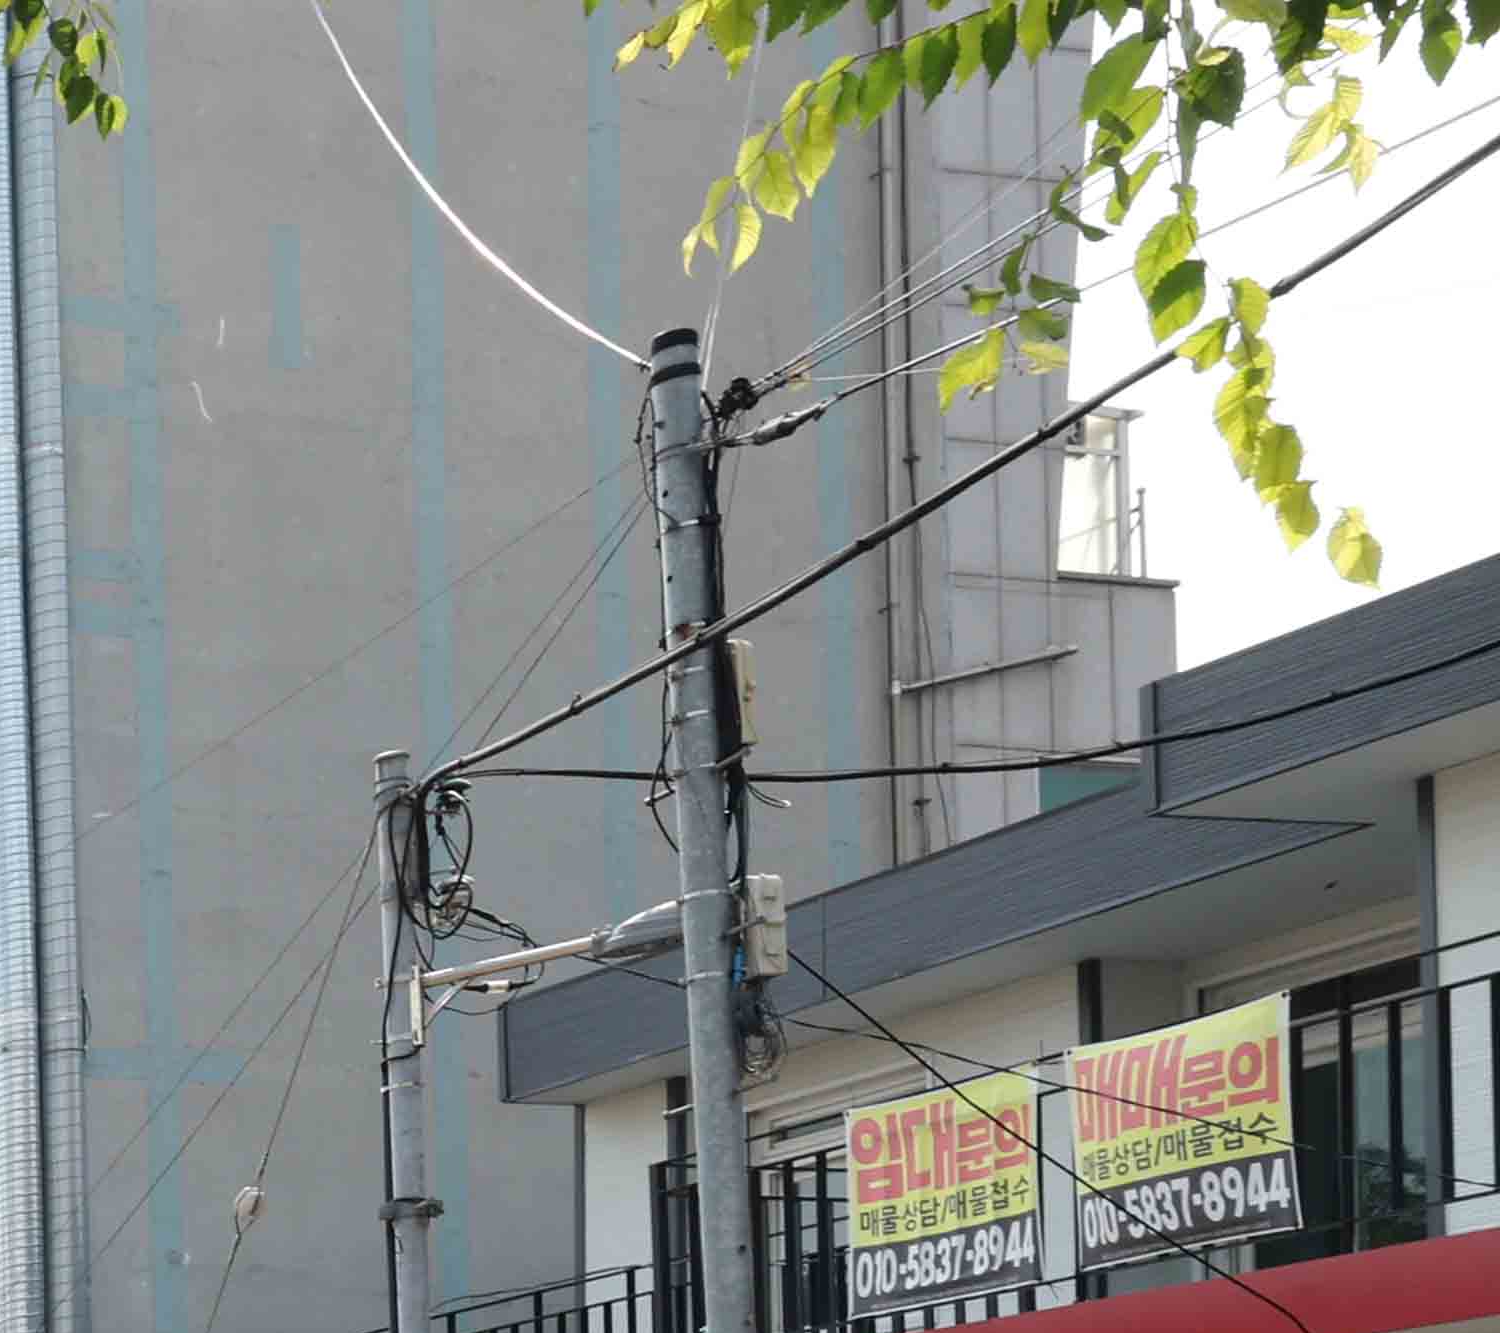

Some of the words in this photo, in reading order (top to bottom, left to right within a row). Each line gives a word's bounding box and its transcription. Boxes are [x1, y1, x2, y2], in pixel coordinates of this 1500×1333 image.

[1075, 1034, 1280, 1143] 매매문의
[851, 1099, 1032, 1205] 임대문의
[1083, 1157, 1291, 1249] 010-5837-8944
[856, 1216, 1037, 1299] 010-5837-8944
